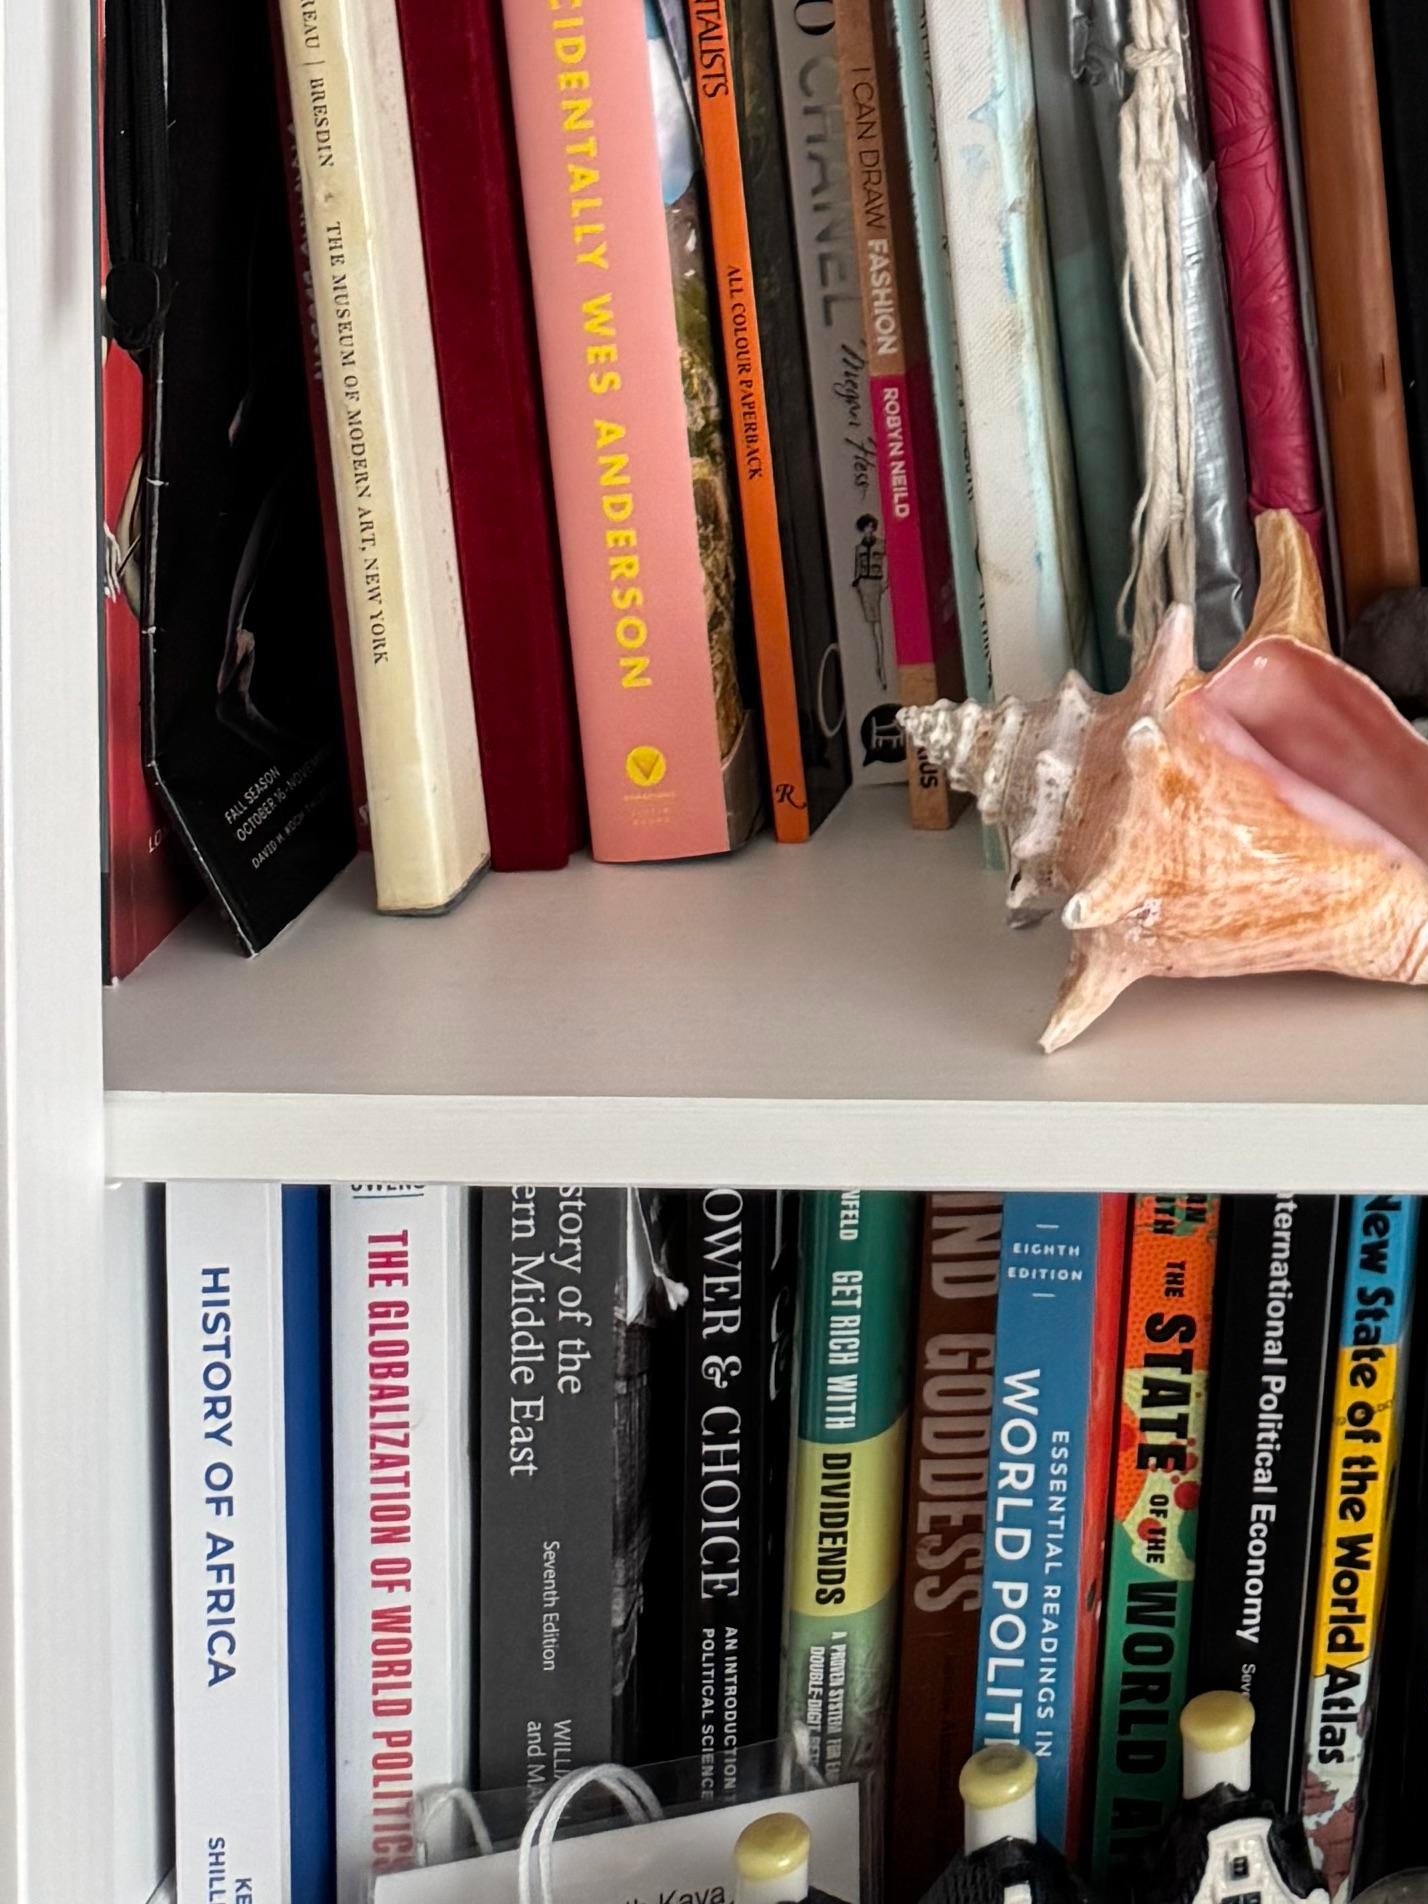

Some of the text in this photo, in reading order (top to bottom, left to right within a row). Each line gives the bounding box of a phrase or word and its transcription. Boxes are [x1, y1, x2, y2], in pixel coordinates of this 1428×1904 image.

[309, 76, 334, 167] BRESDIN
[581, 292, 620, 398] WES
[883, 386, 911, 519] ROBYN NEILD
[592, 420, 651, 690] ANDERSON
[1008, 1266, 1082, 1281] EDITION
[1013, 1242, 1080, 1258] EIGHTH
[510, 1256, 546, 1477] Middle East
[825, 1270, 862, 1430] GET RICH WITH
[201, 1266, 237, 1688] HISTORY OF AFRICA
[368, 1229, 413, 1717] THE GLOBALIZATION OF WORLD
[701, 1405, 740, 1600] CHOICE
[816, 1453, 851, 1607] DIVIDENDS
[994, 1369, 1042, 1562] WORLD
[543, 1541, 560, 1672] Seventh Edition
[1035, 1430, 1070, 1760] ESSENTIAL READINGS IN
